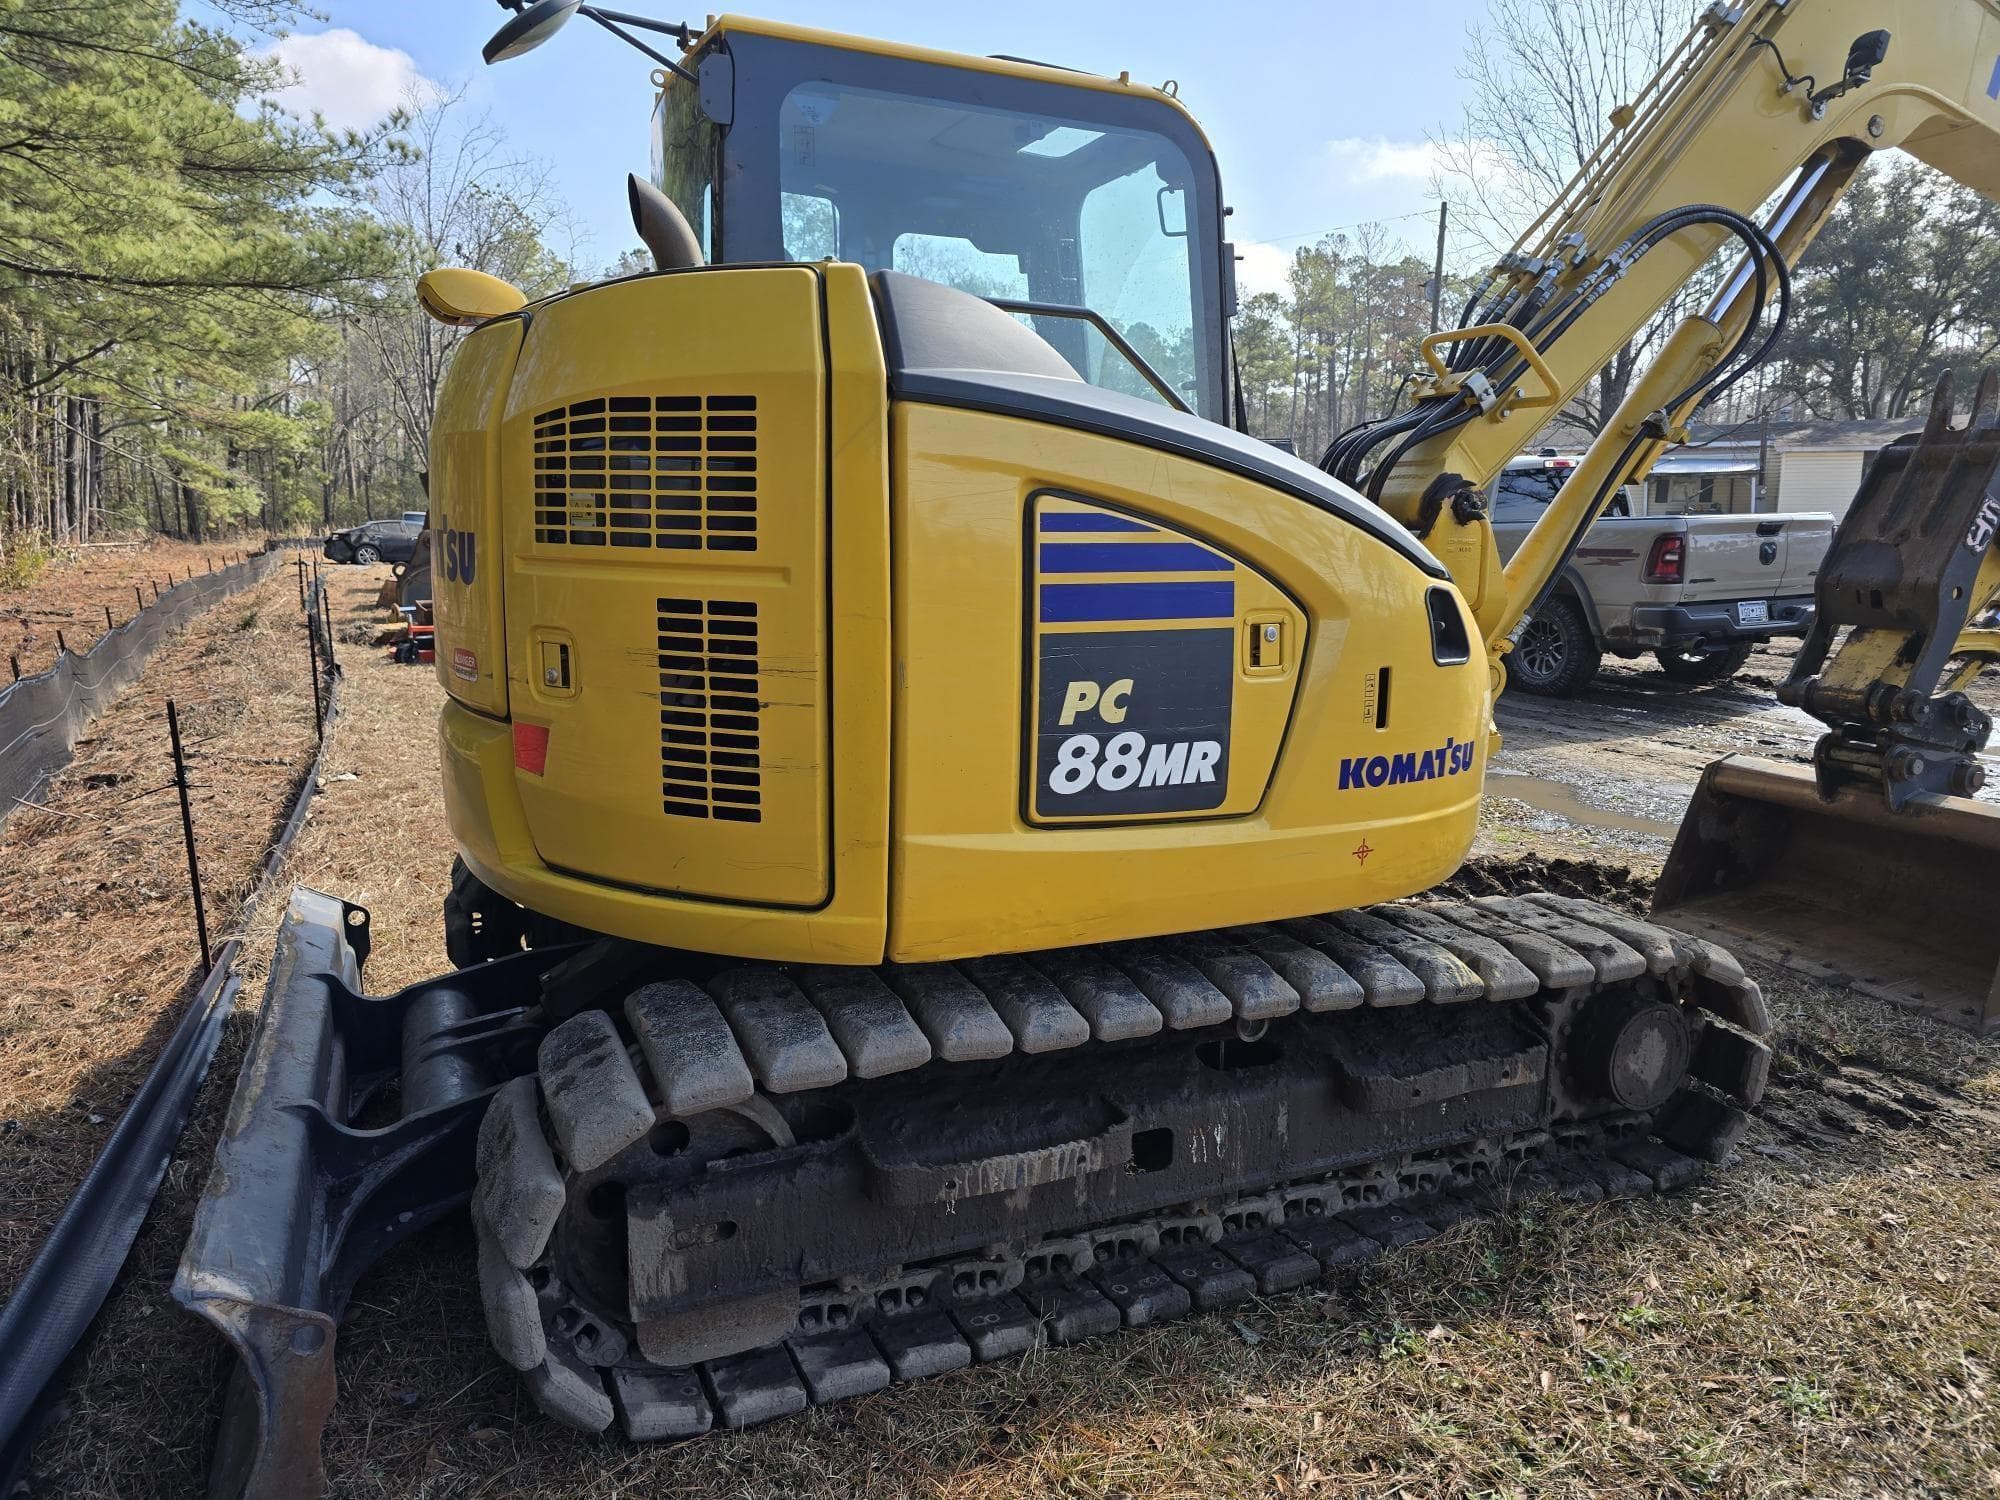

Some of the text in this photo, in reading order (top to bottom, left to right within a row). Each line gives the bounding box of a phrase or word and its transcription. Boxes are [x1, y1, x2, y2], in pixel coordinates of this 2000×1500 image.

[1058, 679, 1134, 726] PC
[1049, 731, 1222, 795] 88MR
[1338, 737, 1475, 790] KOMATSU
